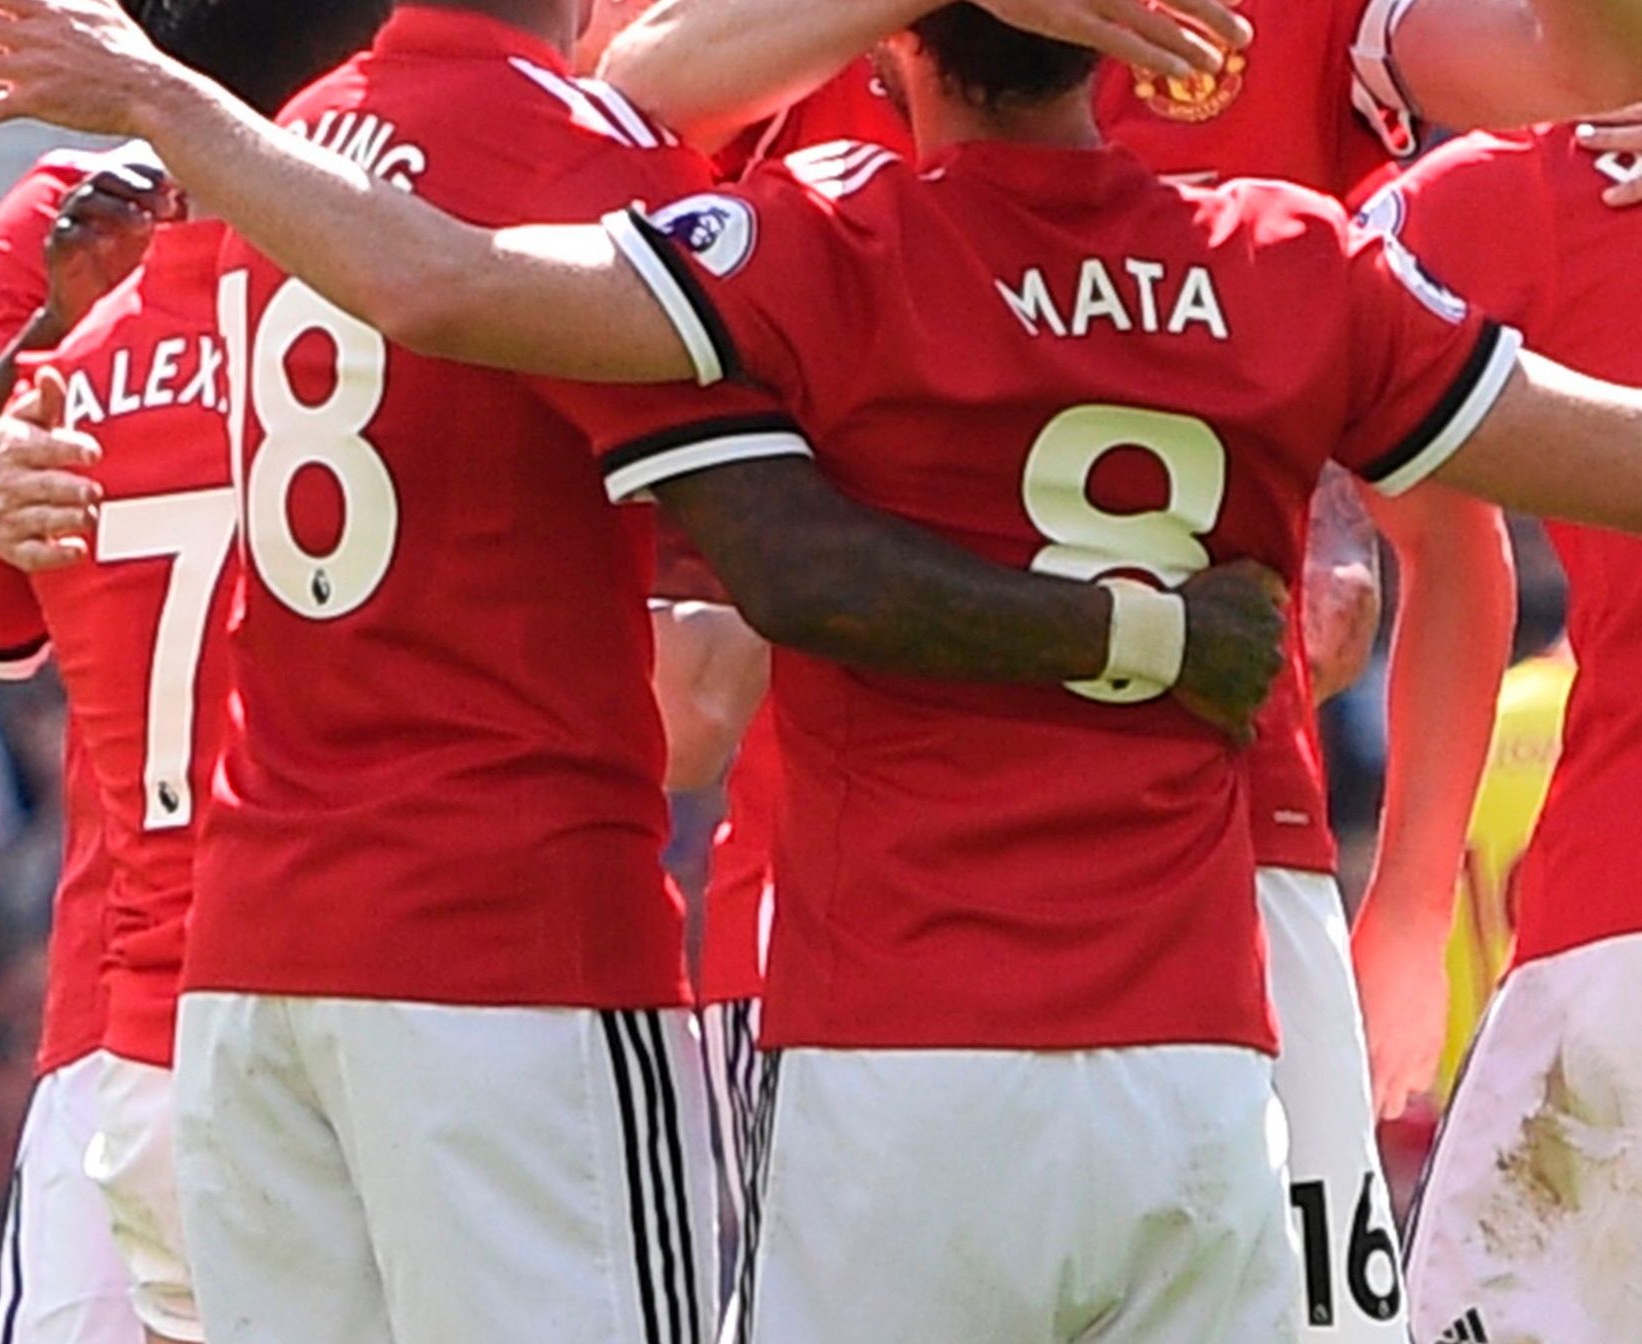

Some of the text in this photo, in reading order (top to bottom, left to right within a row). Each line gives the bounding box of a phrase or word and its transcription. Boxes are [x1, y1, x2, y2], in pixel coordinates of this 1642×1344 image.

[995, 257, 1230, 340] MATA
[63, 335, 229, 432] ALEX
[1021, 403, 1226, 704] 8
[95, 486, 237, 831] 7
[1290, 1170, 1401, 1326] 16
